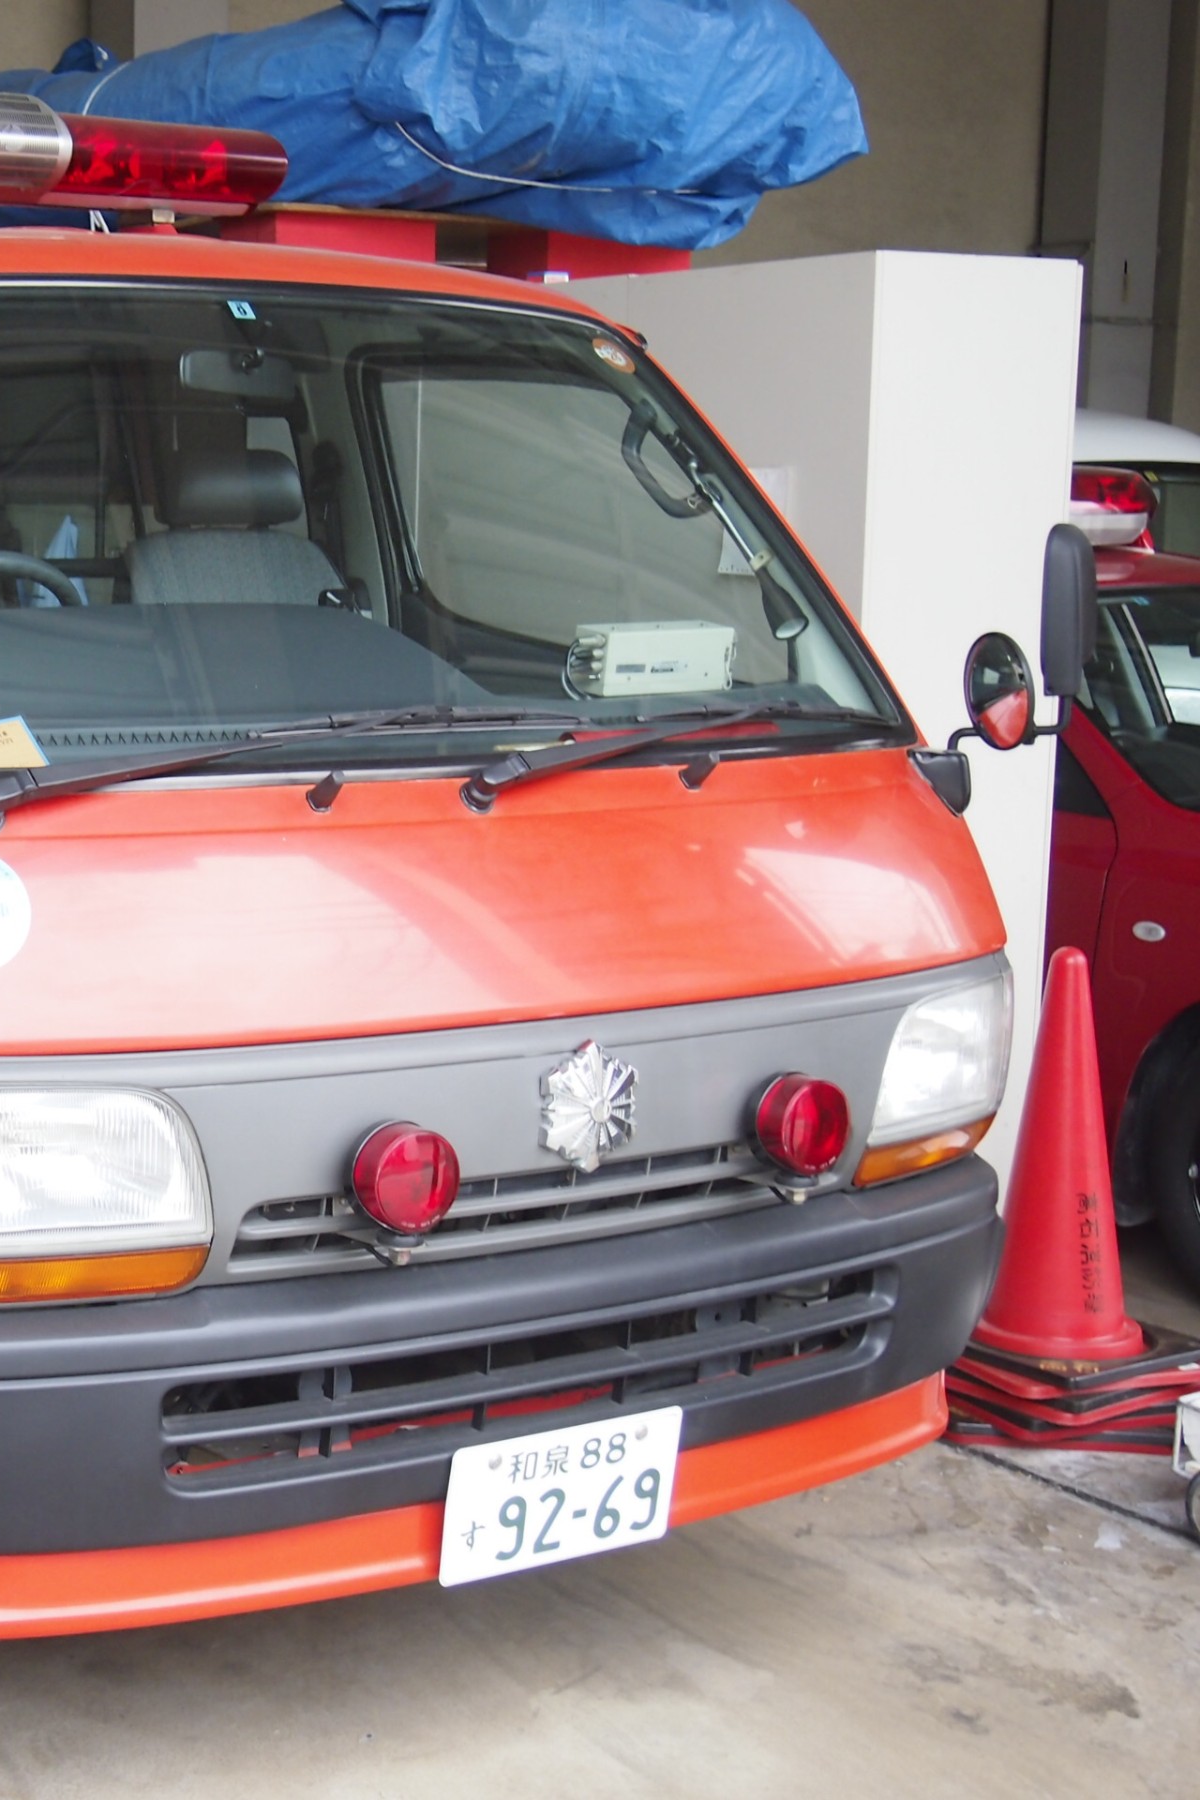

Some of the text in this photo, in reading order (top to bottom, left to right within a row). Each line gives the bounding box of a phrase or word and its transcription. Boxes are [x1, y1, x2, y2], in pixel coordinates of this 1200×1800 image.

[507, 1432, 627, 1484] 和泉 88
[461, 1467, 661, 1561] す 92-69
